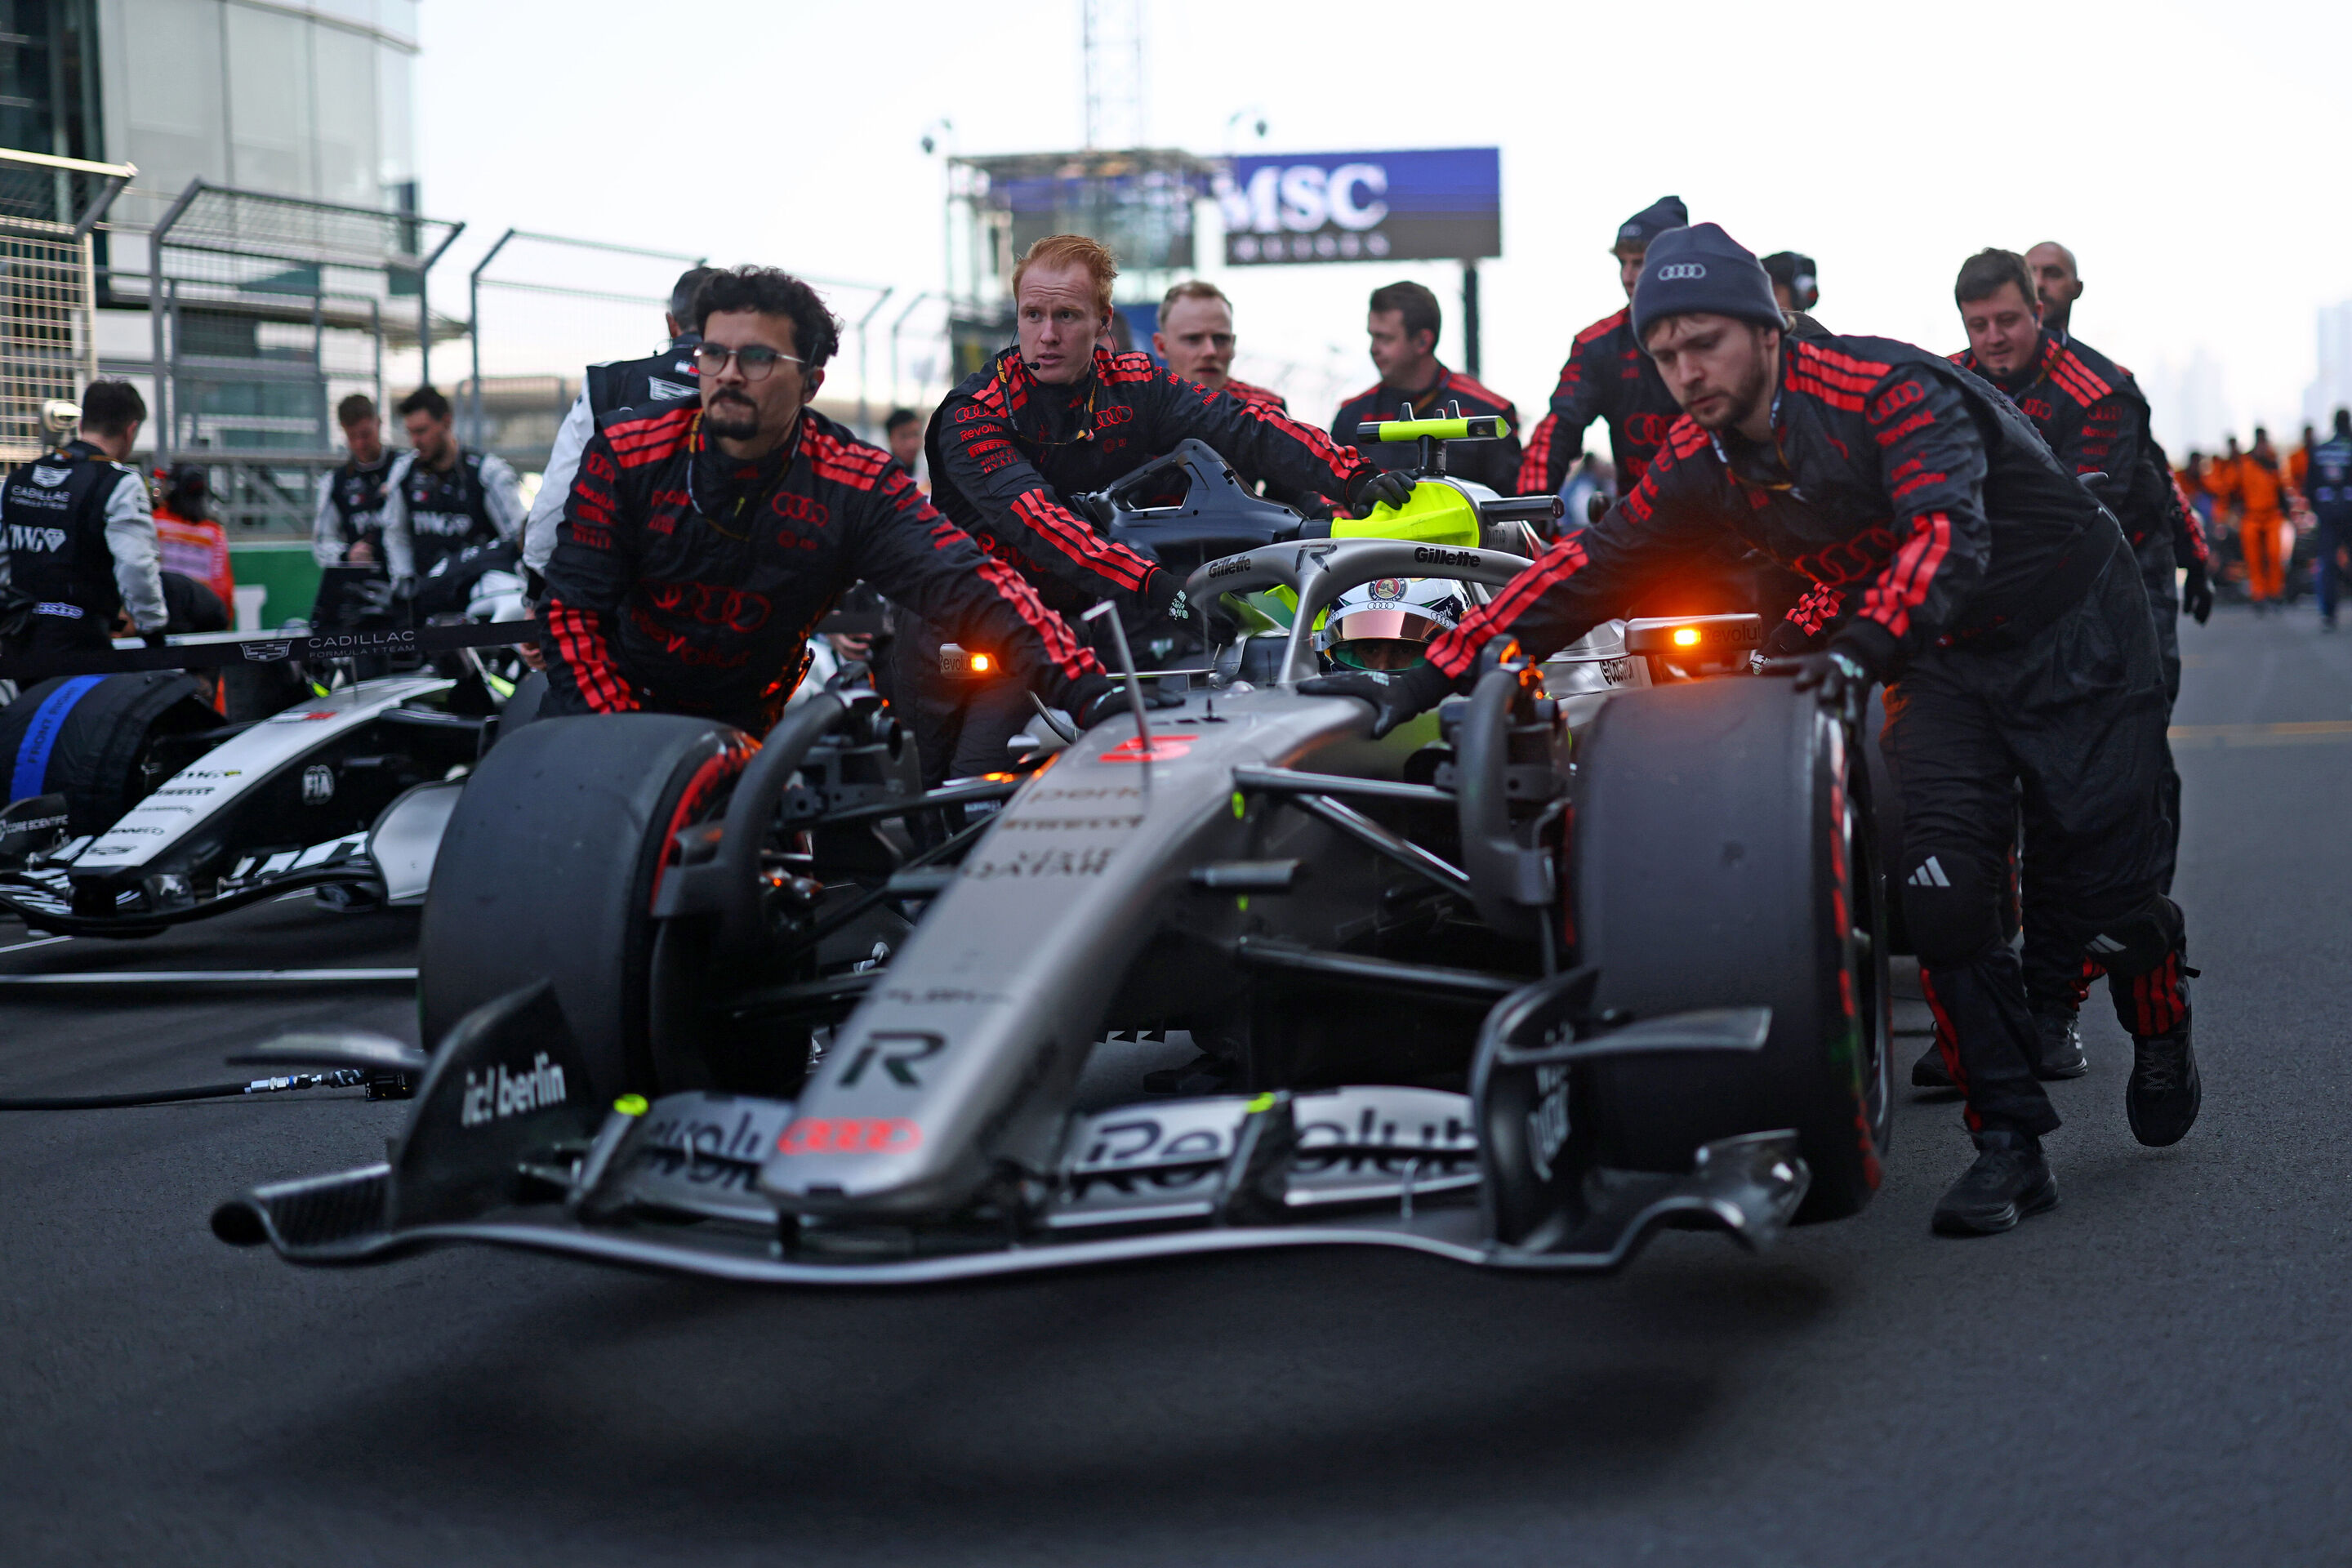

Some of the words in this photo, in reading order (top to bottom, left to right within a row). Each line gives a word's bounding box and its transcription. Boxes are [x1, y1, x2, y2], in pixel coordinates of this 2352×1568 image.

[1208, 555, 1251, 578] Gillette
[1414, 546, 1481, 568] Gillette
[308, 630, 415, 648] CADILLAC
[309, 648, 368, 659] FORMULA
[382, 644, 415, 653] TEAM
[940, 654, 973, 671] Revolu
[305, 773, 333, 798] FIA
[838, 1028, 946, 1087] R
[497, 1050, 567, 1118] berlin
[1071, 1107, 1479, 1201] Reolut
